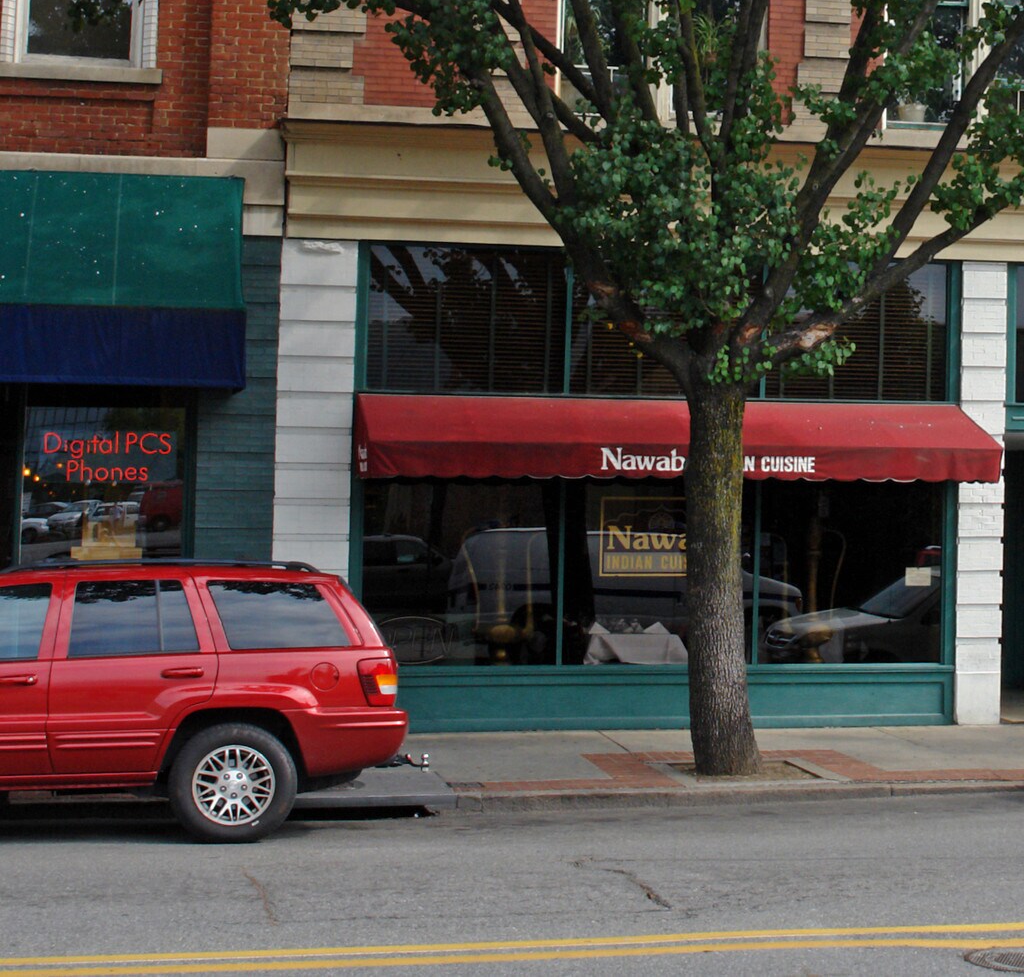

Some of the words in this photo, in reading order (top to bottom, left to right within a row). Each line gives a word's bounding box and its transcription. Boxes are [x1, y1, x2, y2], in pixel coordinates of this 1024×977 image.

[43, 431, 119, 459] Digital
[125, 432, 172, 455] PCS
[66, 460, 149, 481] Phones
[600, 447, 686, 471] Nawab
[761, 456, 816, 473] CUISINE
[606, 525, 687, 550] Nawa
[606, 555, 653, 570] INDIAN
